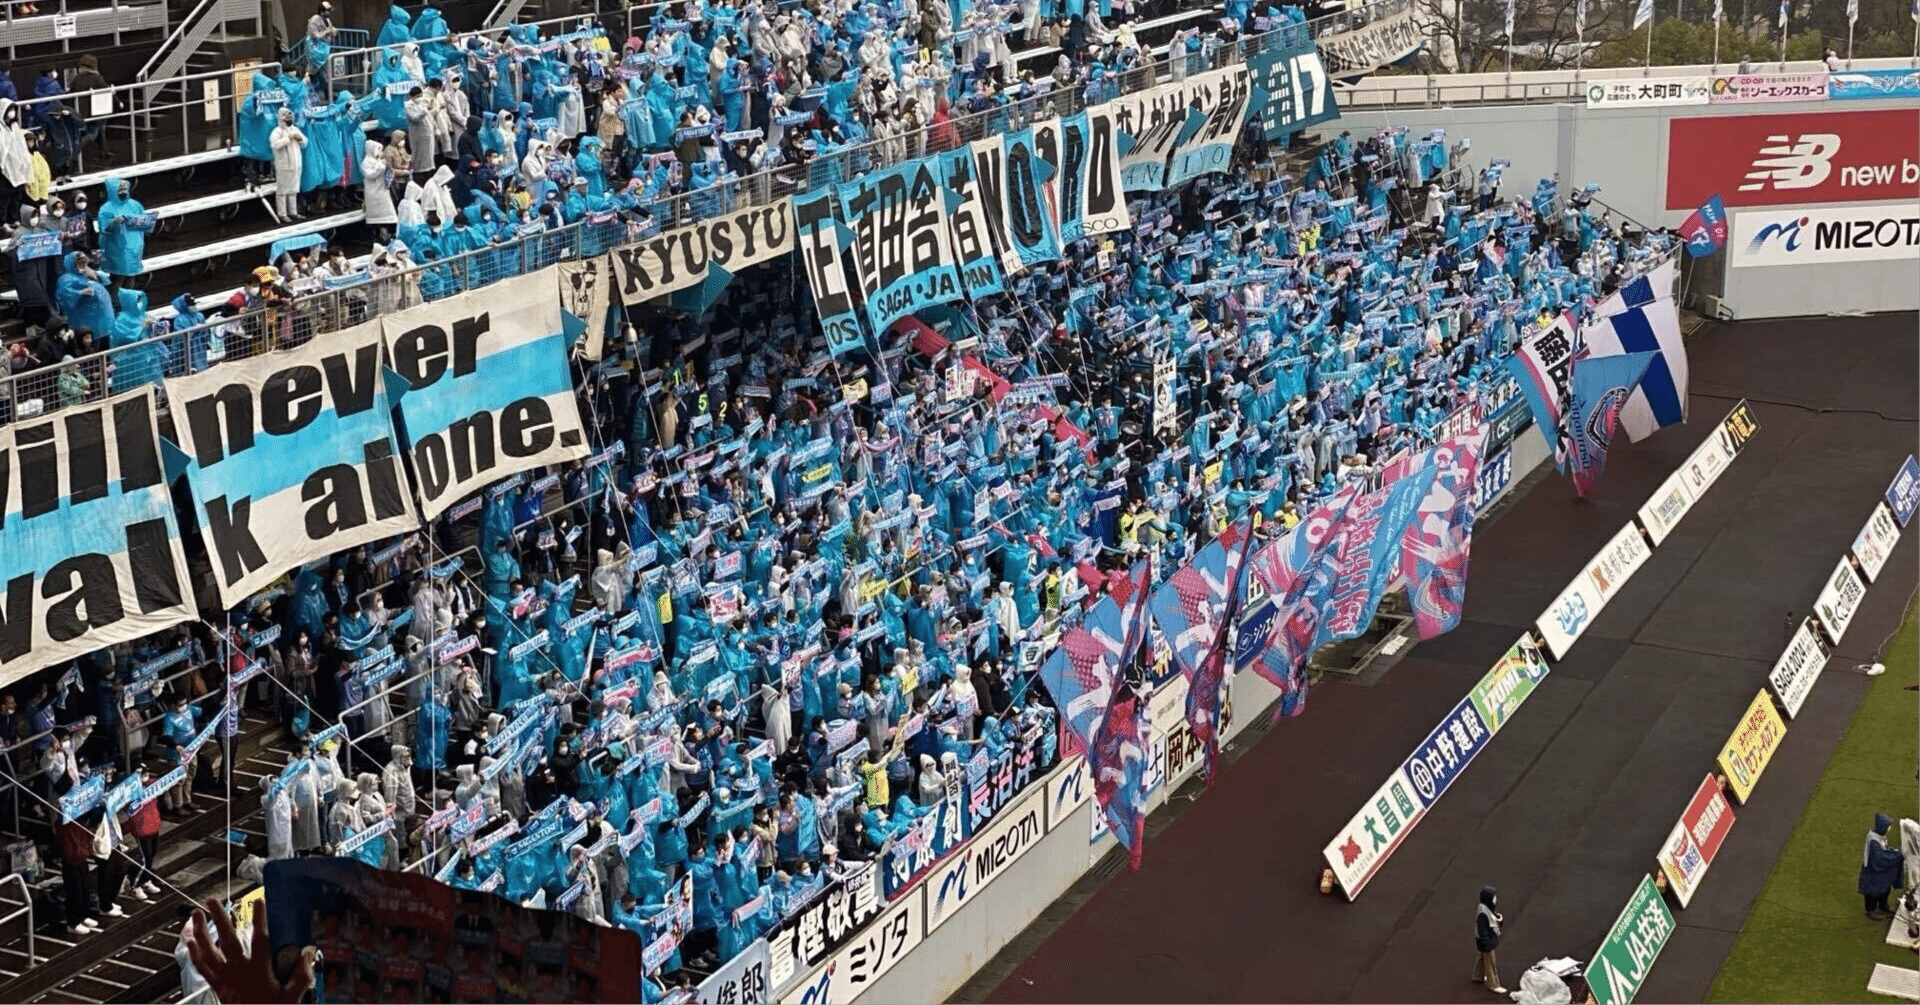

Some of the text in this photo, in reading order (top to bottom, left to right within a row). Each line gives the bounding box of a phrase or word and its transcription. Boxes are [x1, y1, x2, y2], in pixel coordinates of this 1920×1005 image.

[1638, 84, 1682, 99] 大町町
[1751, 85, 1826, 97] シーエックスカーゴ
[1841, 164, 1896, 187] new
[622, 202, 788, 294] KYUSYU
[877, 284, 912, 321] SAGA
[185, 308, 490, 467] never
[1773, 640, 1807, 697] SAGA 2024
[1426, 706, 1484, 780] 中野建設
[976, 810, 1038, 885] MIZOTA
[1364, 780, 1415, 853] 大昌園
[850, 907, 909, 984] ミゾタ
[1620, 893, 1672, 986] JA共済
